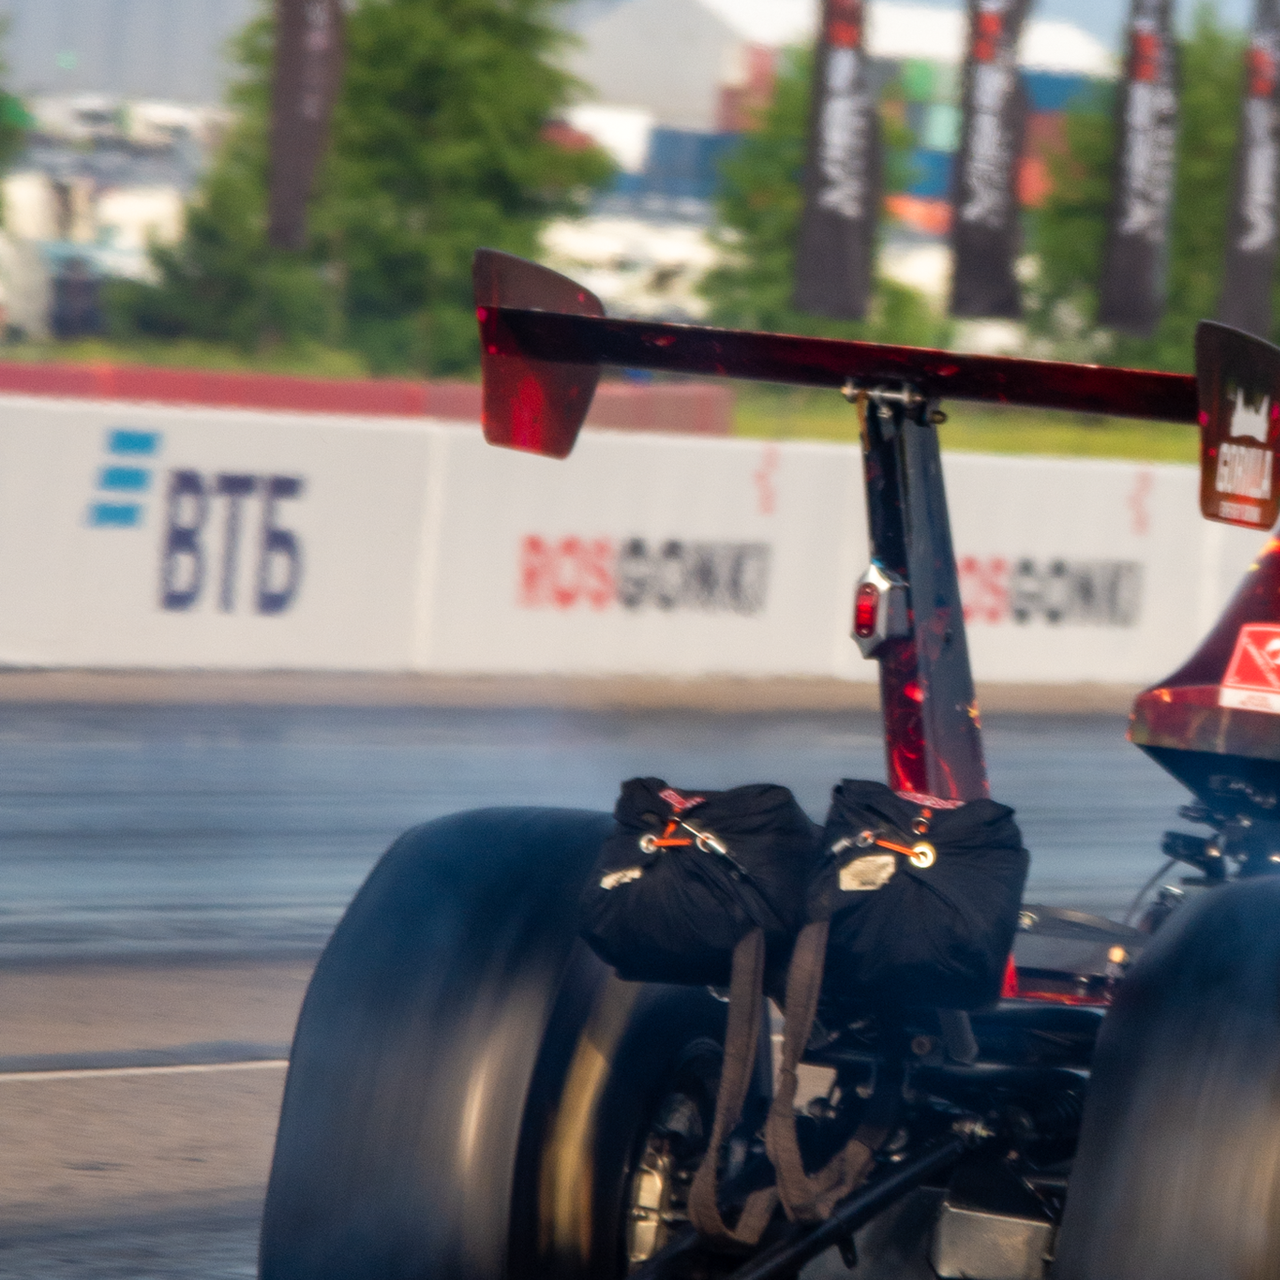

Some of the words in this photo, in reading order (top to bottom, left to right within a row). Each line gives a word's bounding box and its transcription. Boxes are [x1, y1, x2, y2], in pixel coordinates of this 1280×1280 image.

[1216, 442, 1273, 499] GORILLA
[160, 469, 306, 616] ВТБ
[956, 555, 1145, 627] OSGONKI
